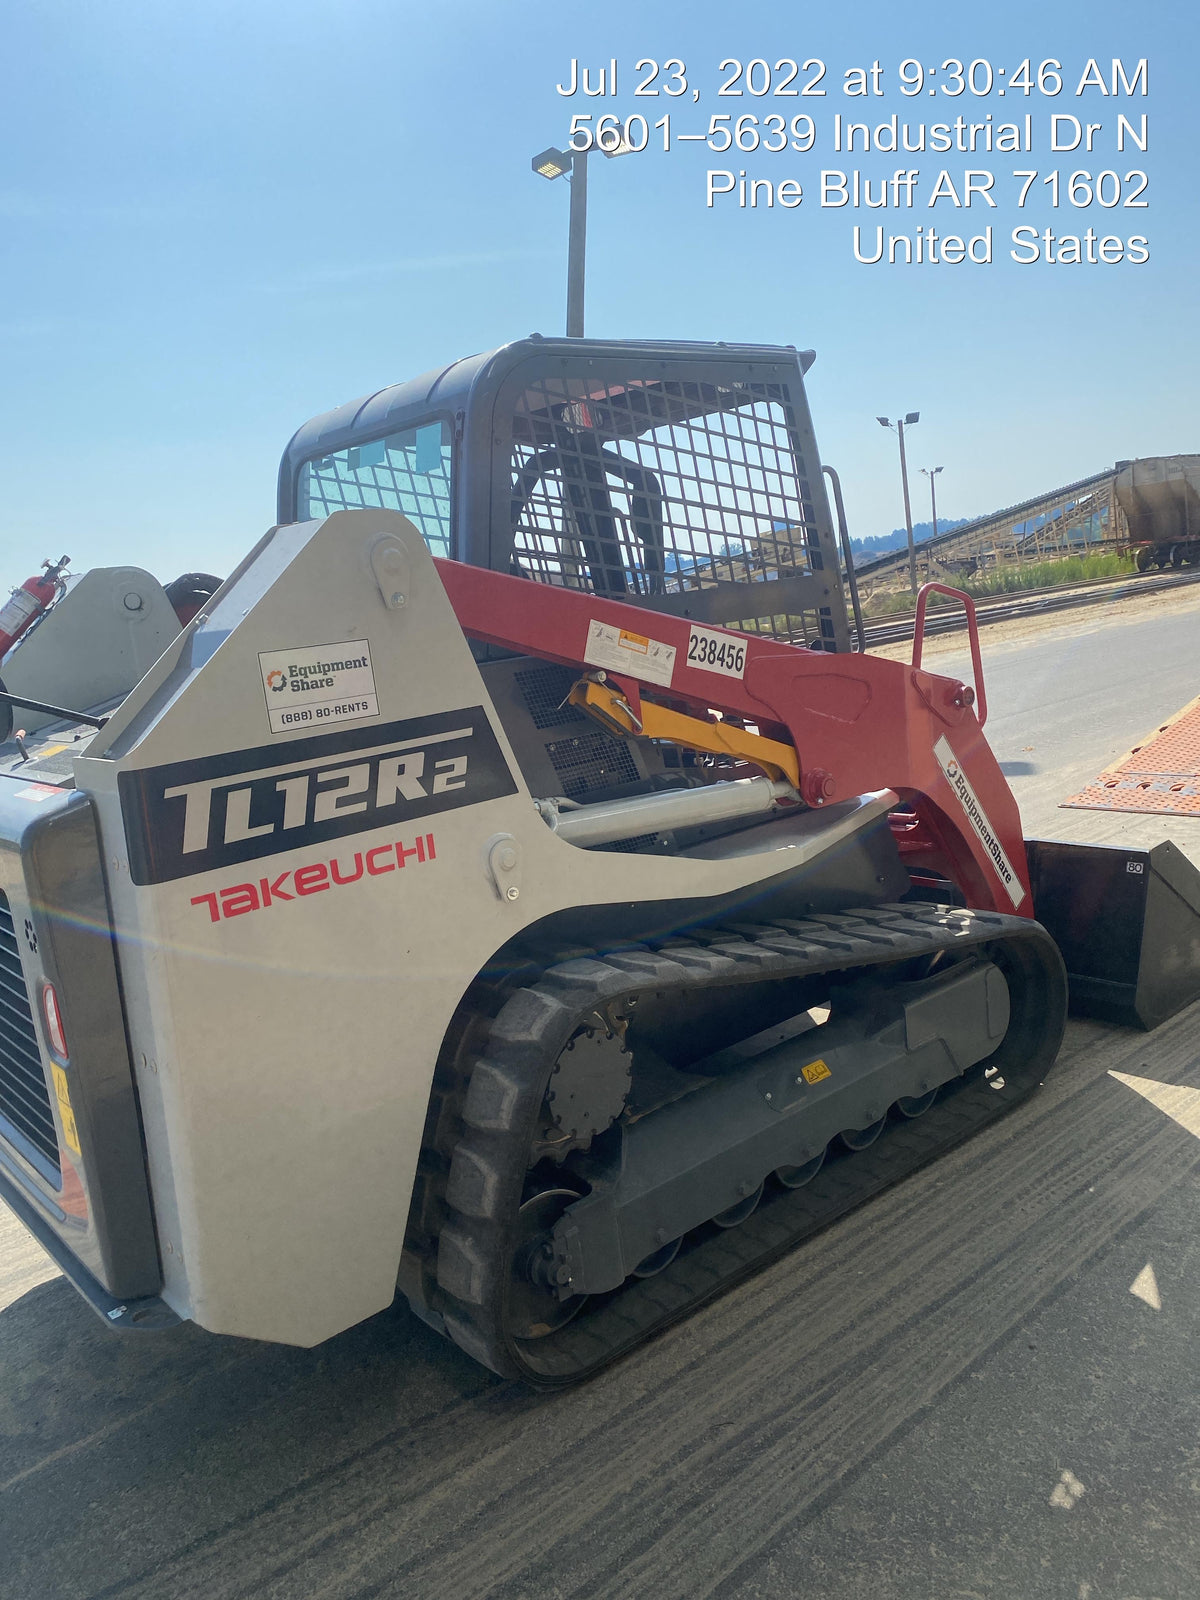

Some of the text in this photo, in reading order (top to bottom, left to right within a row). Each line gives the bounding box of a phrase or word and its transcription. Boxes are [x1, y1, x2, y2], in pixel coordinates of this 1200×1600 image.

[688, 634, 745, 673] 238456
[288, 656, 369, 679] Equipment
[290, 677, 335, 693] Share
[281, 701, 369, 725] (888) 80-RENTS
[163, 727, 474, 855] TL12R2
[954, 774, 1013, 884] EquipmentShare
[1128, 862, 1142, 873] 80
